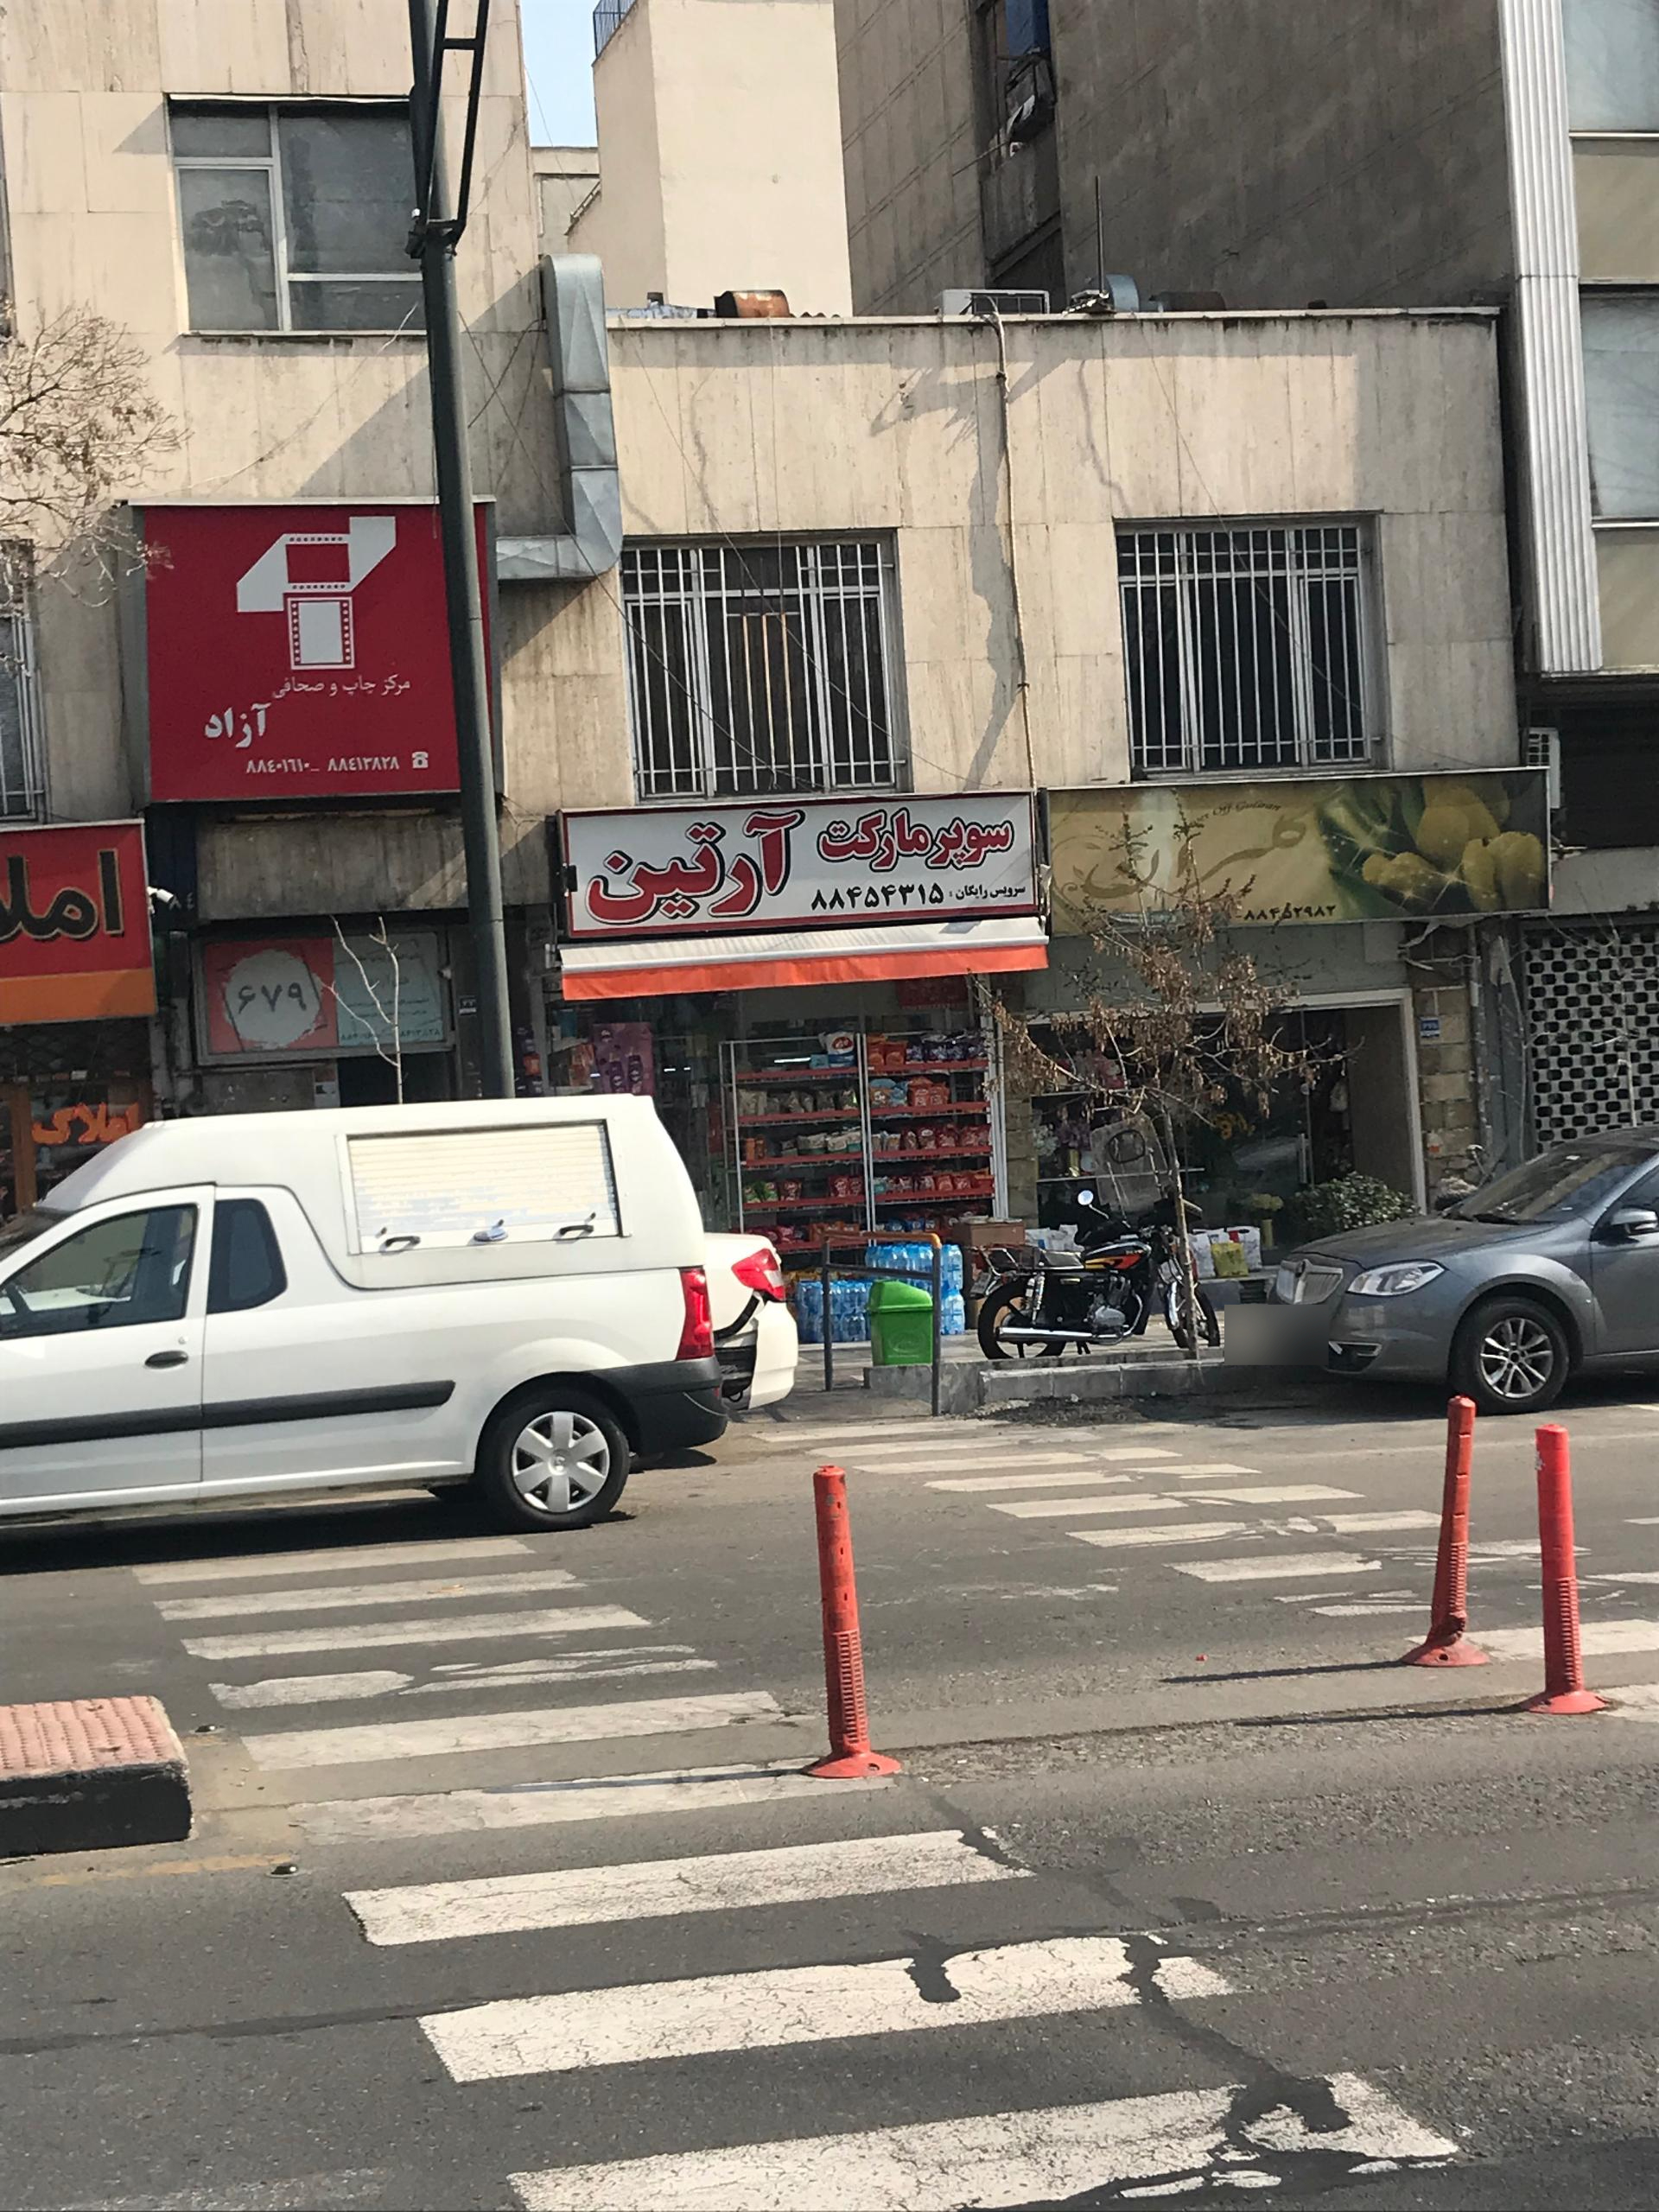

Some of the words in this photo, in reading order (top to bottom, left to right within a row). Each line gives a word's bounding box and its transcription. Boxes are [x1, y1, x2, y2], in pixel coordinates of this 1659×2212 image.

[272, 676, 324, 699] صحافی
[329, 684, 338, 697] و
[342, 675, 376, 696] چاپ
[381, 674, 410, 696] مرکز
[204, 702, 271, 748] آزاد
[584, 809, 805, 925] آرتین
[810, 882, 945, 912] ۸۸۴۵۴۳۱۵
[989, 885, 1027, 899] سرویس
[238, 982, 308, 1014] ۶۷۹
[31, 1102, 140, 1145] املاک
